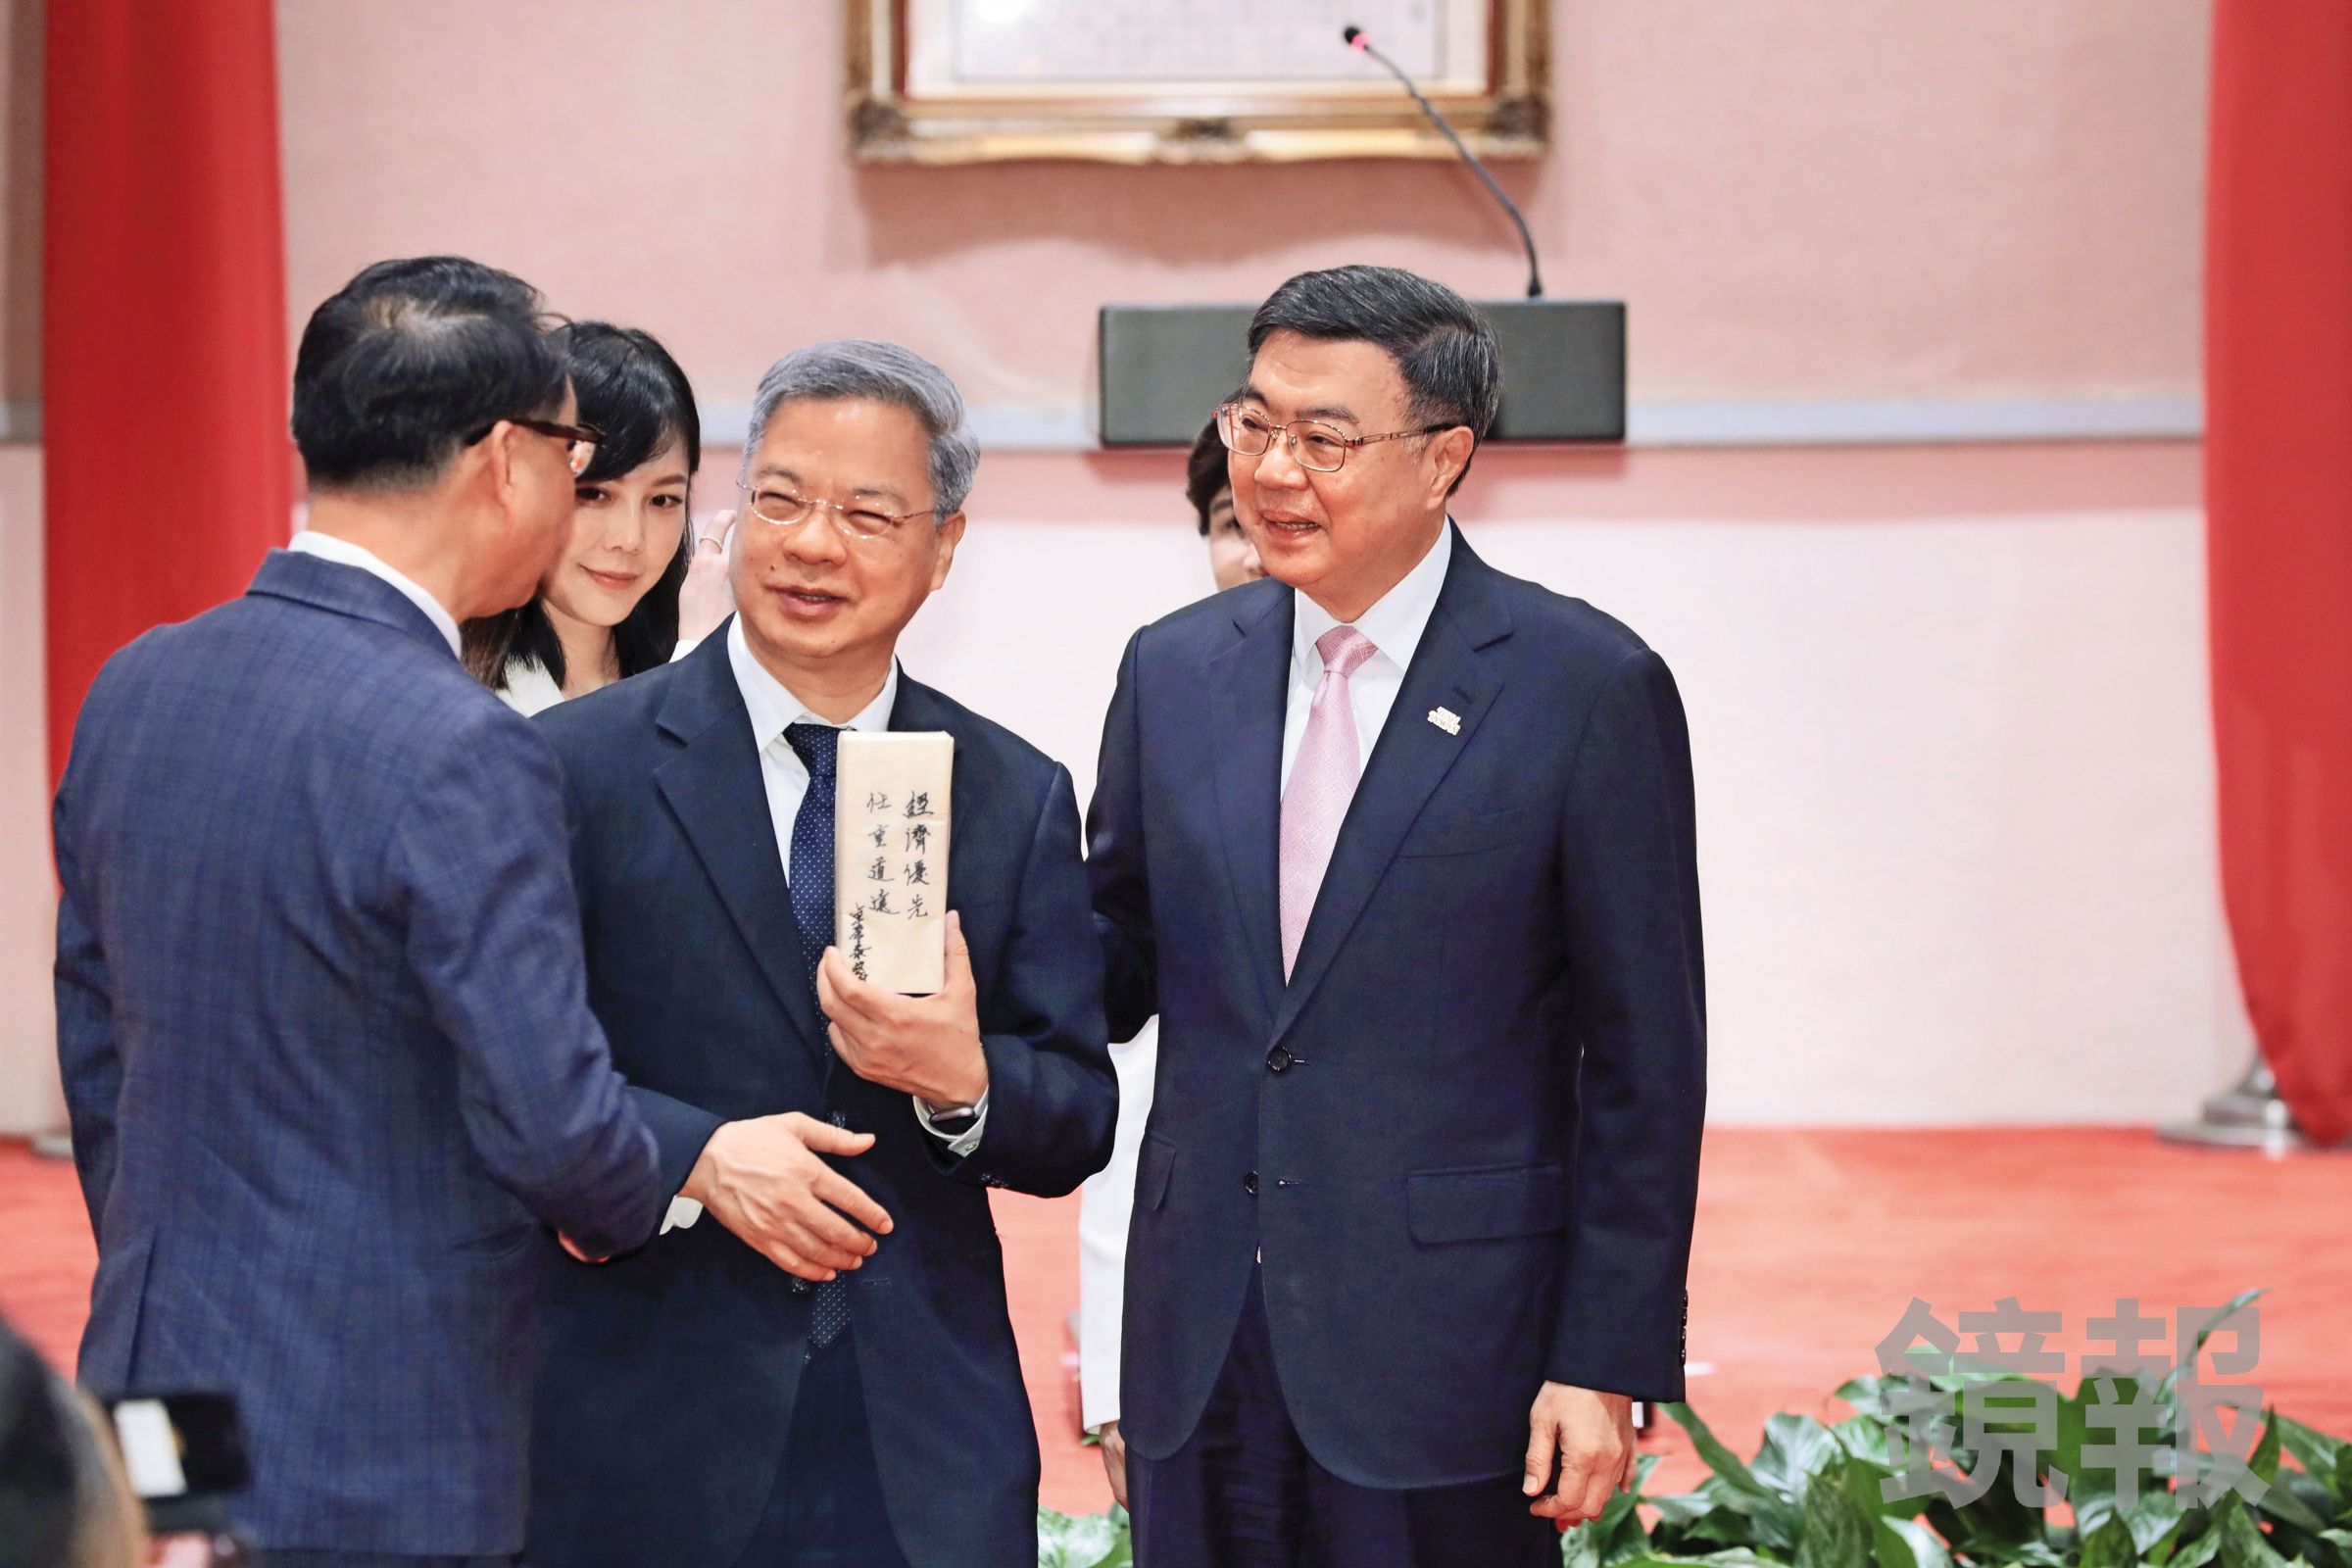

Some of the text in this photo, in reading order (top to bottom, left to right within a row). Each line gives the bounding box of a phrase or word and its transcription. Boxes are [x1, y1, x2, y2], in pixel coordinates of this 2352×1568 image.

[866, 791, 901, 914] 任重道遠
[903, 790, 935, 920] 經濟優先
